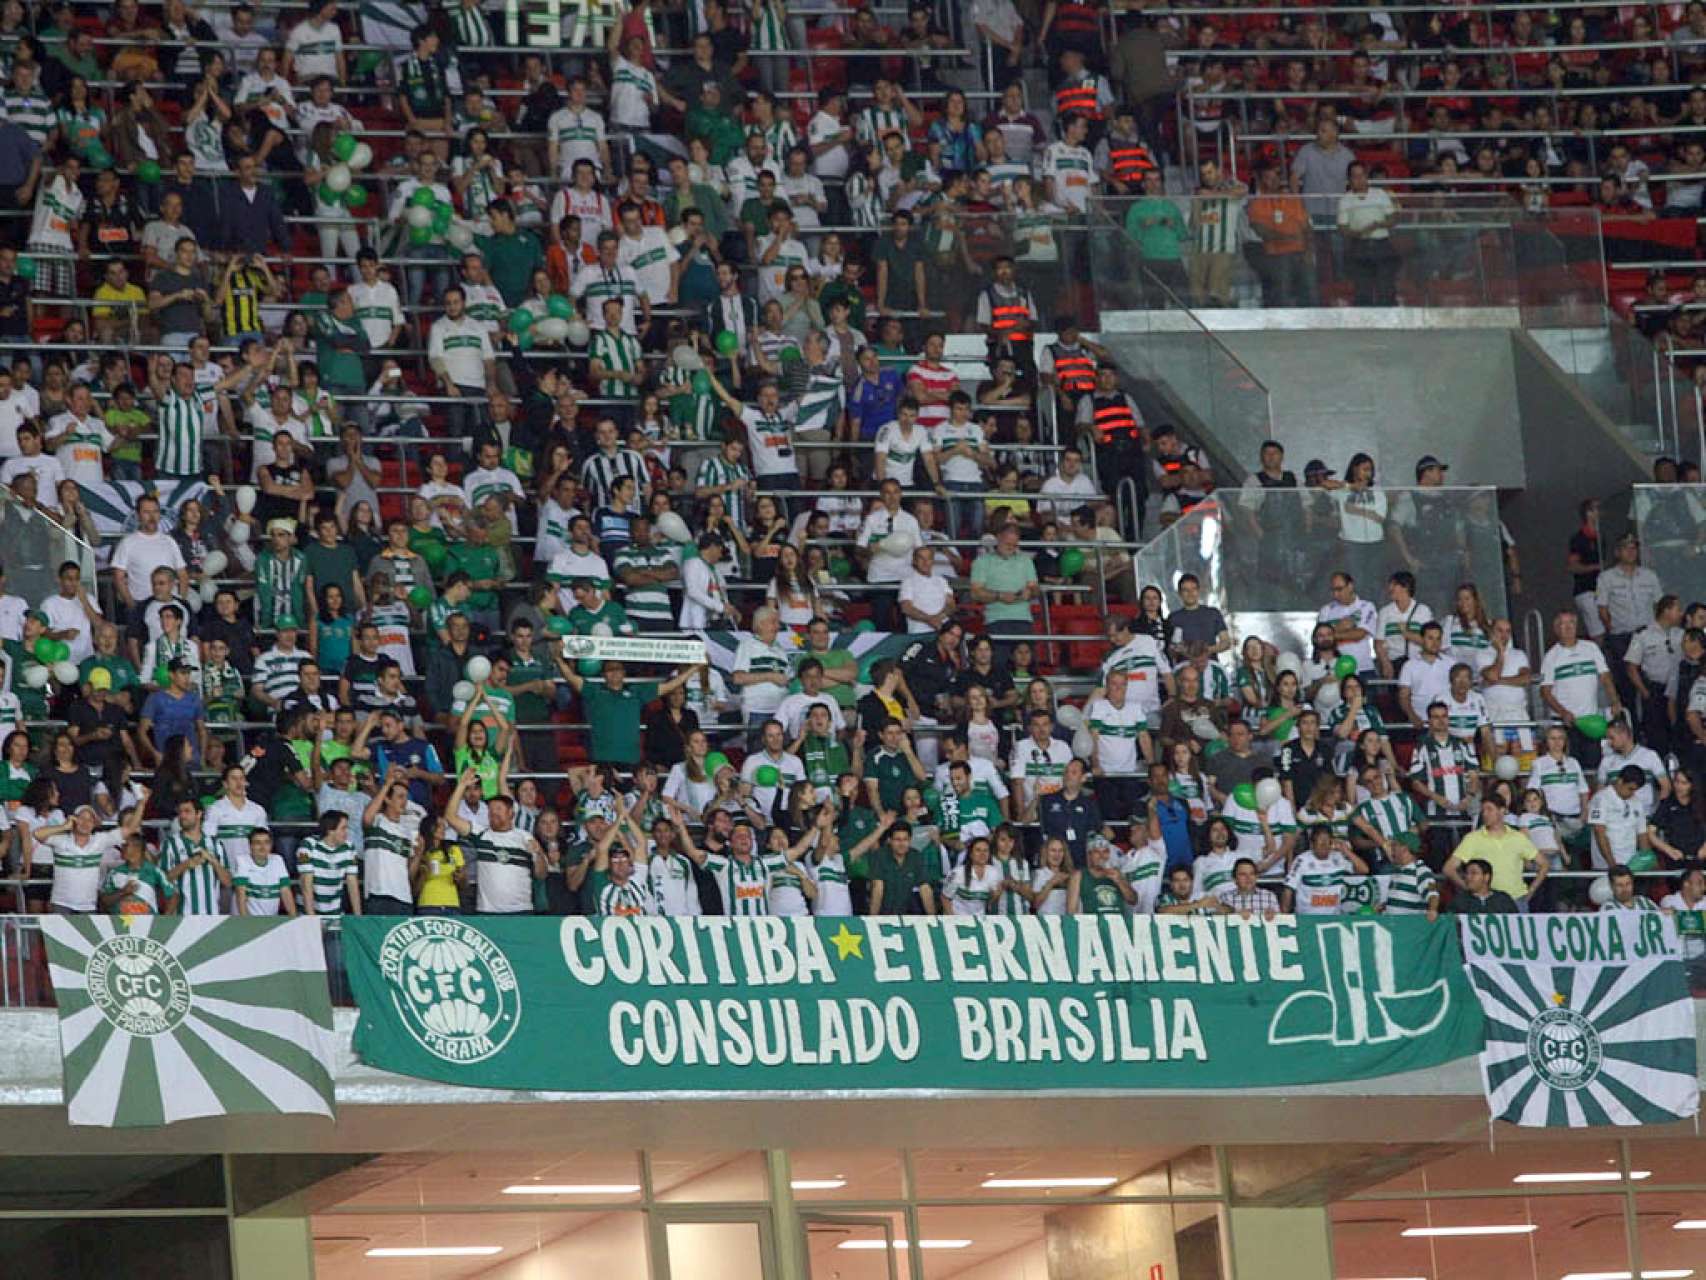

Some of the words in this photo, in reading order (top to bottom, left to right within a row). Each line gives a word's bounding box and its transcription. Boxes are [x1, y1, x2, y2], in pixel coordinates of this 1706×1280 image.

[560, 914, 837, 986] CORITIBA
[860, 913, 1305, 984] ETERNAMENTE
[1468, 913, 1540, 960] SOLU
[1547, 915, 1627, 962] COXA
[1634, 912, 1676, 958] JR.
[115, 974, 164, 998] CFC
[407, 964, 486, 1005] CFC
[608, 996, 920, 1066] CONSULADO
[952, 991, 1208, 1063] BRASÍLIA
[1543, 1039, 1585, 1059] CFC
